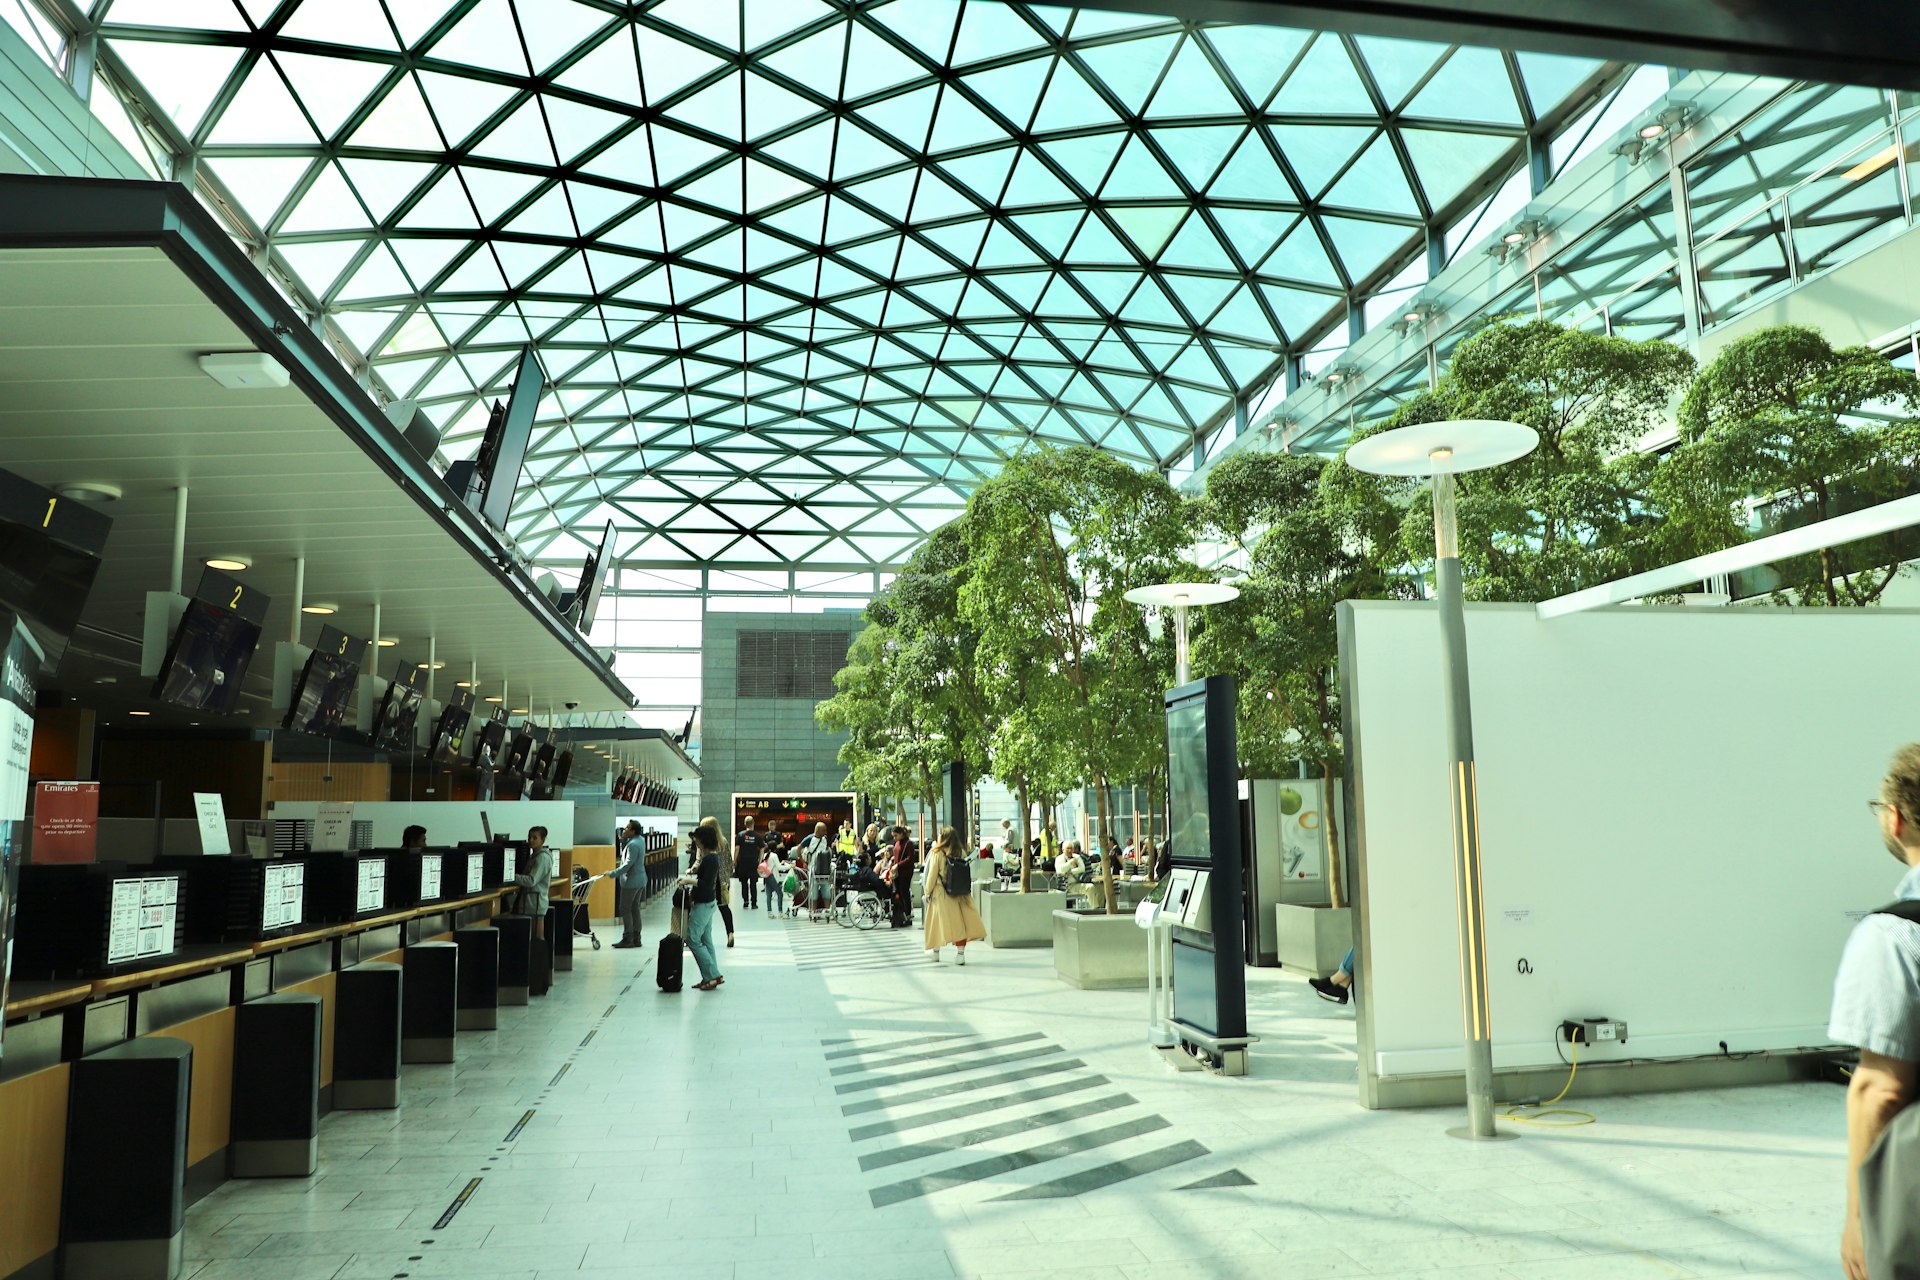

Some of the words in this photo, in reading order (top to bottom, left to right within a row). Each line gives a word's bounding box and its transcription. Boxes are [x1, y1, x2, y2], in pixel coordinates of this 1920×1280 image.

[42, 498, 57, 528] 1
[229, 585, 243, 609] 2
[338, 636, 349, 655] 3
[410, 669, 417, 686] 4
[461, 692, 467, 706] 5
